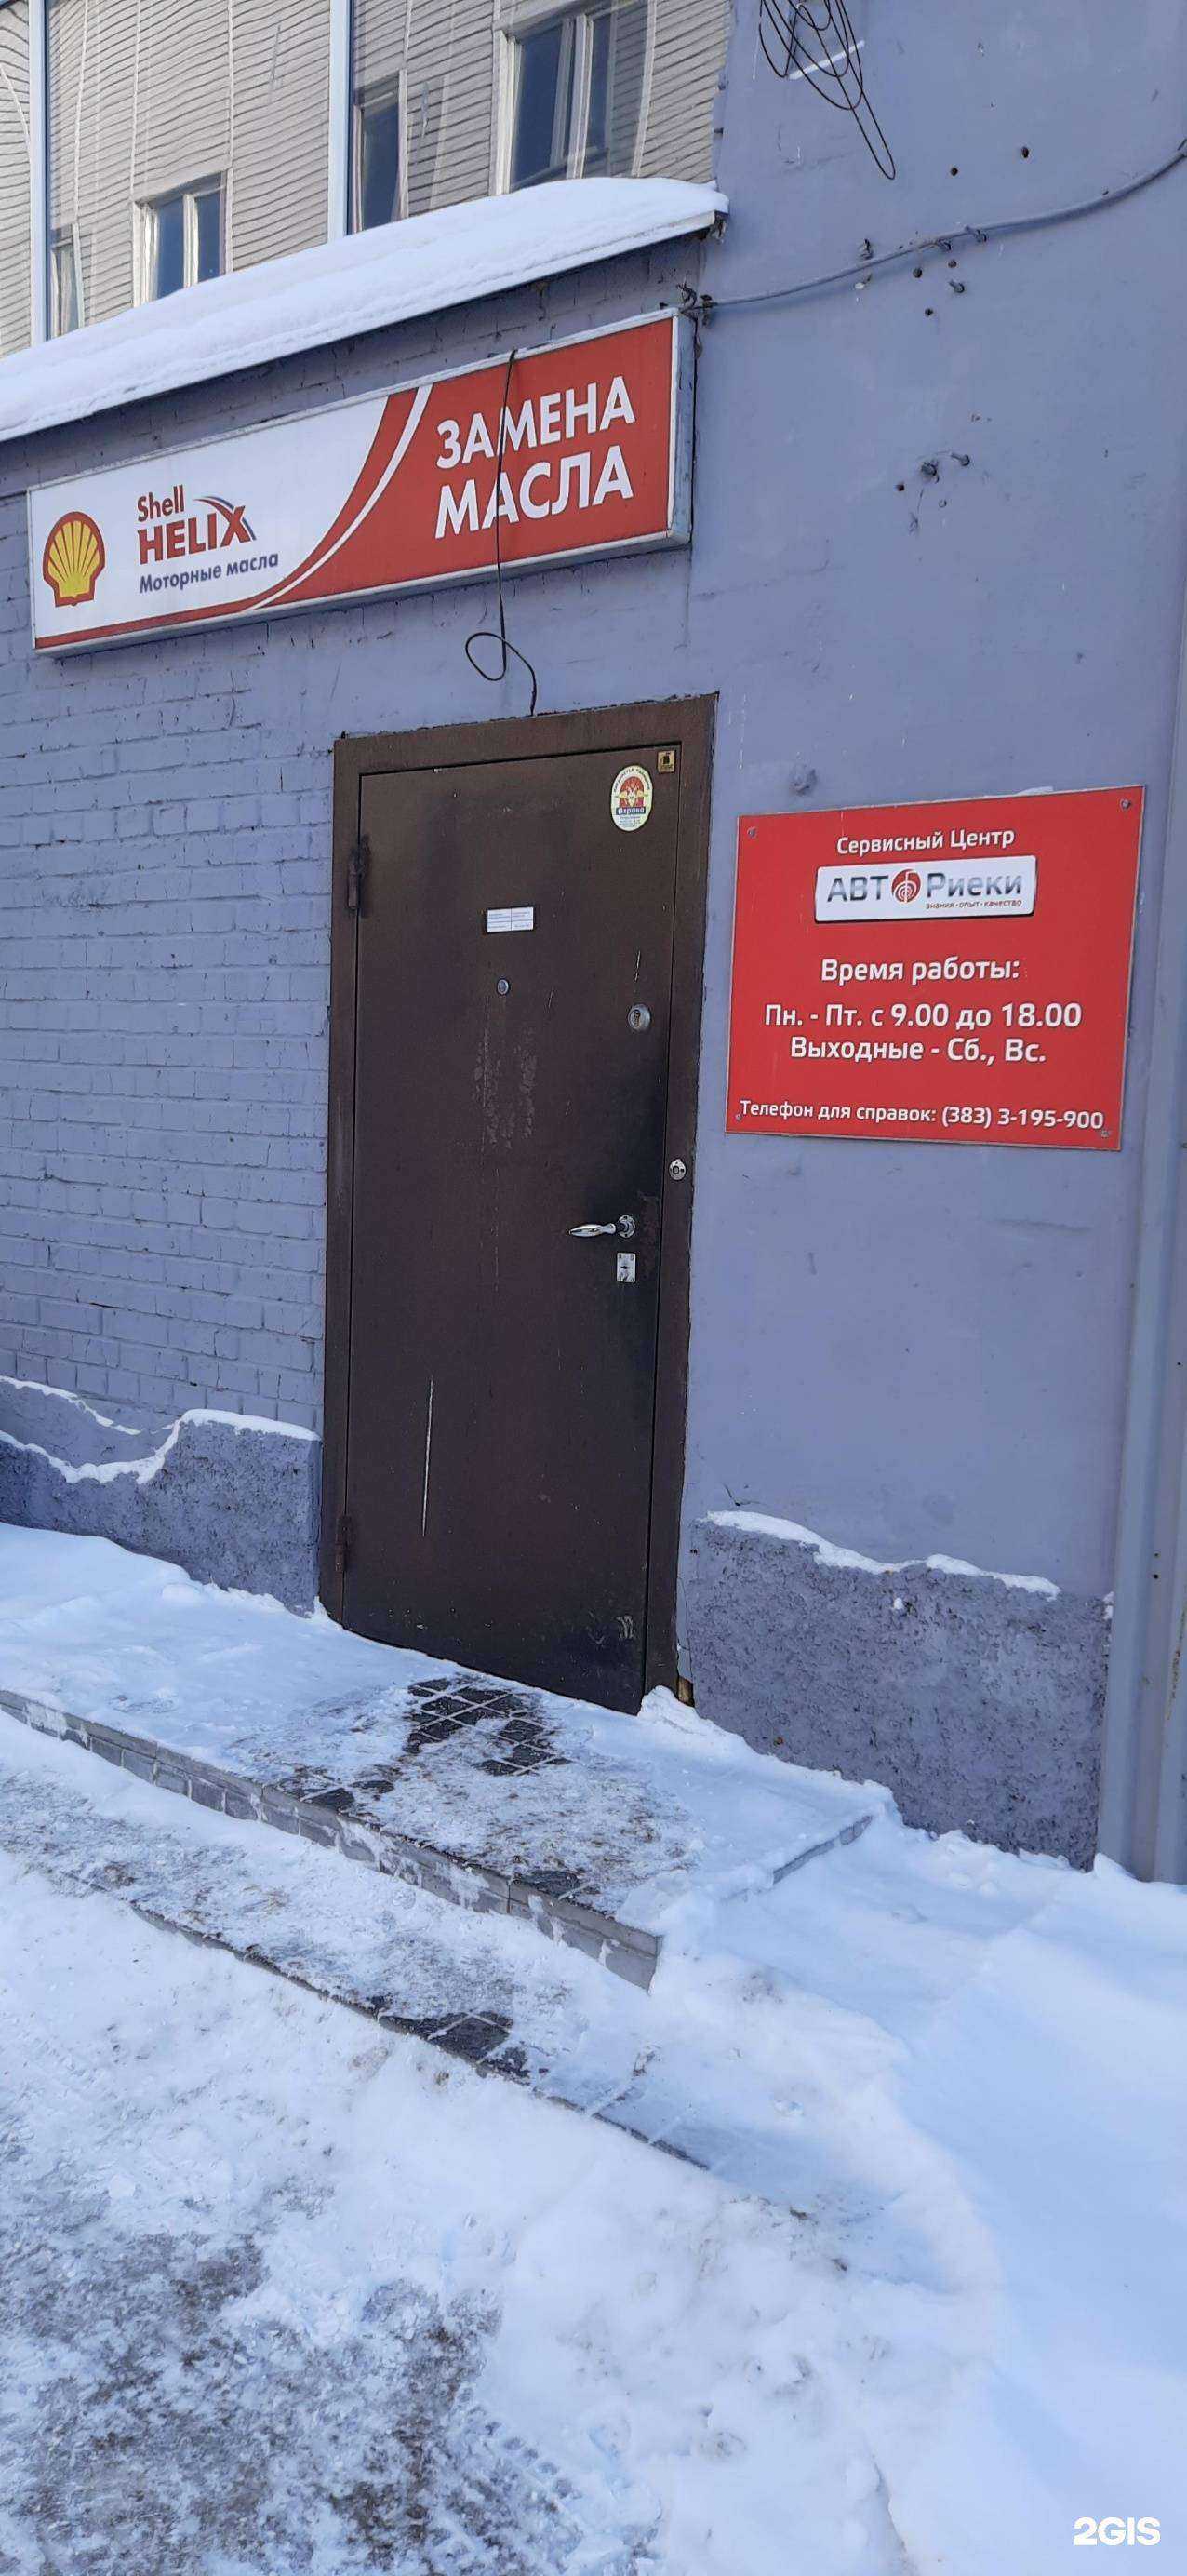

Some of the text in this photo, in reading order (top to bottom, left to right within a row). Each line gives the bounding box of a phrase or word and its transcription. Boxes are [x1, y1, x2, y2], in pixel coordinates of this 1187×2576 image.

[434, 374, 636, 471] ЗАМЕНА
[137, 483, 185, 523] Shell
[434, 443, 634, 541] МАСЛА
[138, 496, 257, 565] HELIX
[139, 553, 279, 594] Моторные масла
[836, 829, 1015, 857] Сервисный Центр
[821, 956, 1020, 986] Время работы:
[765, 1004, 803, 1026] Пн.
[825, 1003, 862, 1026] Пт.
[871, 1009, 884, 1026] с
[890, 1003, 949, 1027] 9.00
[955, 1009, 992, 1031] до
[1001, 1002, 1082, 1027] 18.00
[791, 1036, 924, 1063] Выходные
[947, 1037, 995, 1066] Сб.,
[1005, 1038, 1046, 1062] Вс.
[740, 1100, 1104, 1130] Телефон для справок: (383) 3-195-900
